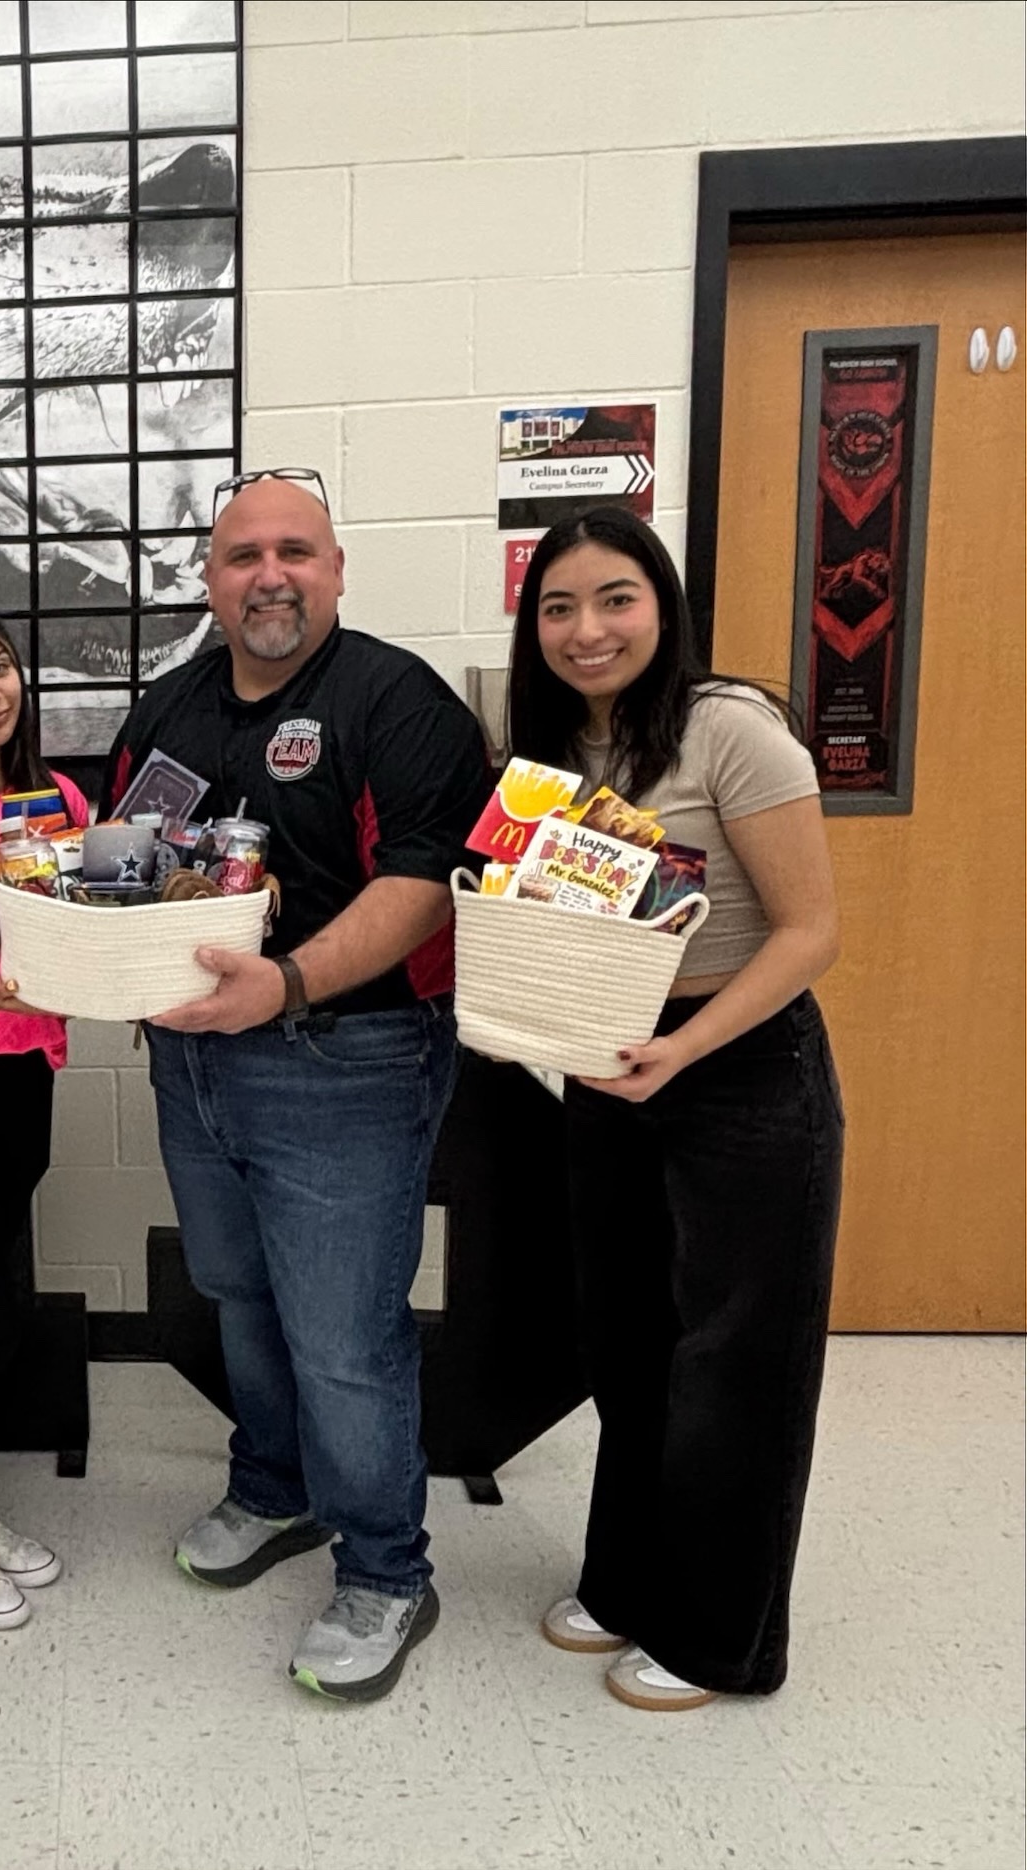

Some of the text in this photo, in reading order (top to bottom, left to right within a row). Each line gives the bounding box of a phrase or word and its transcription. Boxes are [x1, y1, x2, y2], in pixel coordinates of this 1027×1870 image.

[521, 464, 609, 478] Evelina Garza
[529, 481, 604, 491] Campus Secretary
[515, 546, 536, 563] 21
[267, 739, 318, 765] TEAM
[573, 832, 622, 863] Happy
[546, 864, 566, 879] Mr.
[567, 871, 615, 899] Gonzalez
[596, 861, 639, 892] DAY
